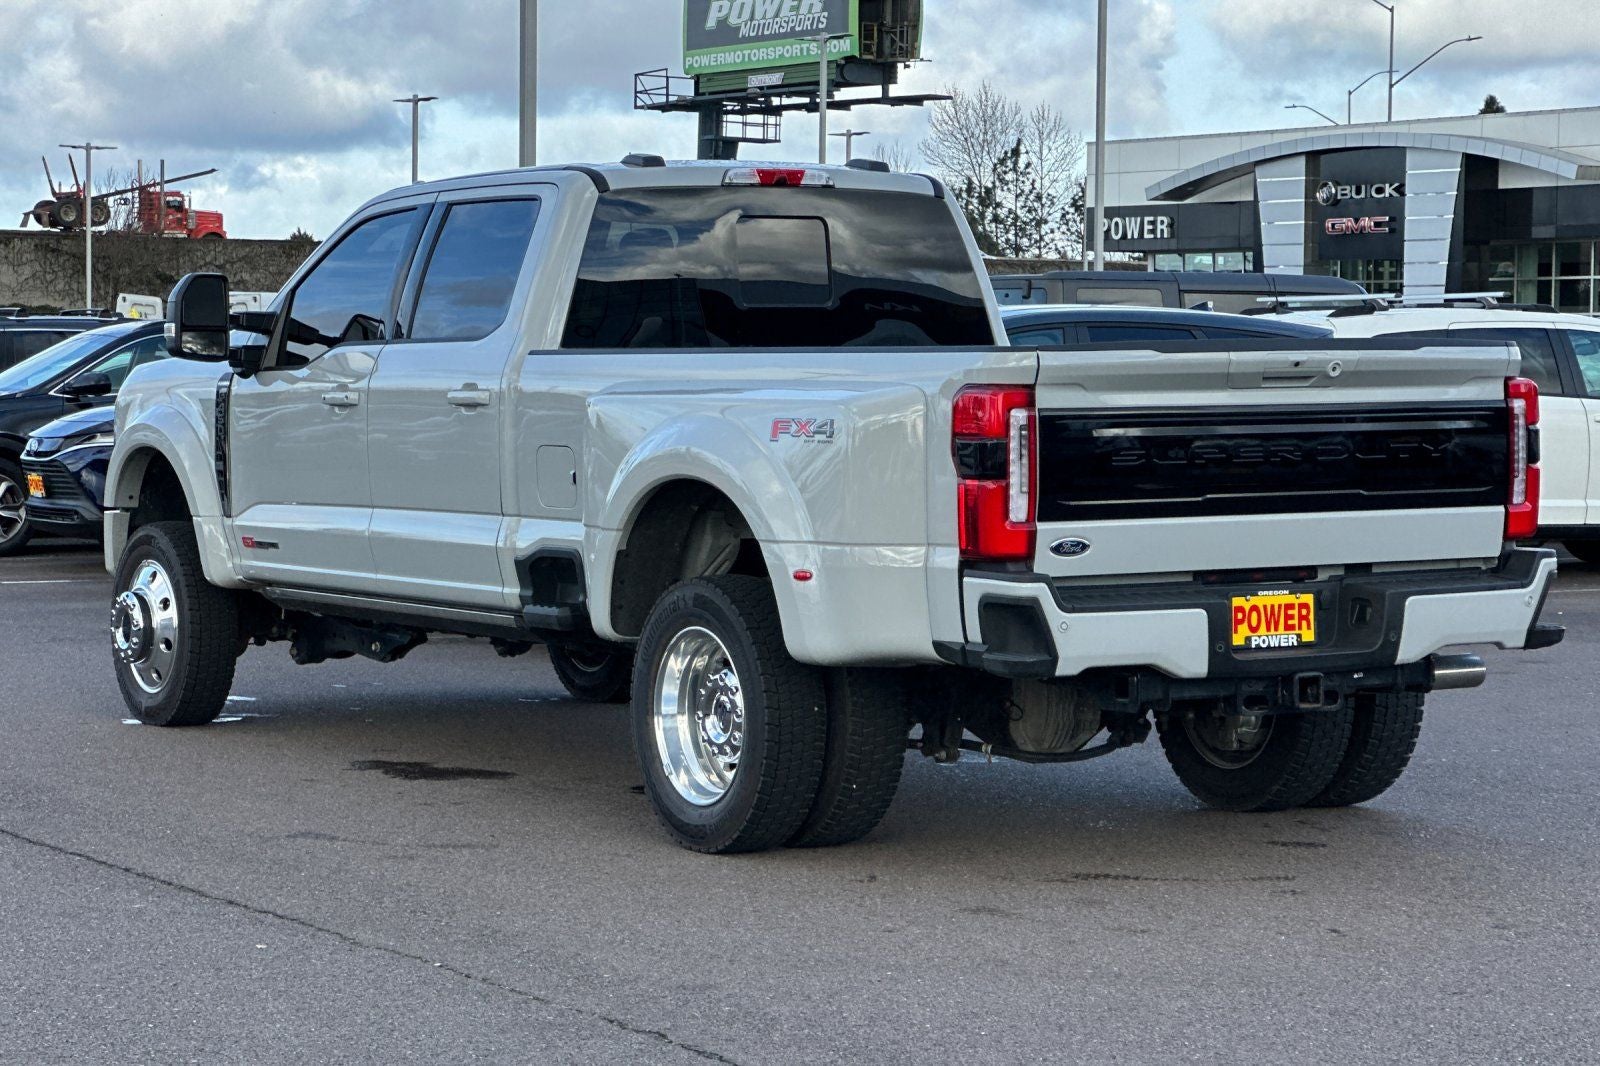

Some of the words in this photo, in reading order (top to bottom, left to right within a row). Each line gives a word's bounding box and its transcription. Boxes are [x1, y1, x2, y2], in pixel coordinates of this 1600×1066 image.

[739, 11, 829, 38] MOTORSPORTS
[685, 38, 851, 69] POWERMOTORSPORTS.OM
[1337, 182, 1401, 200] BUICK
[1325, 216, 1389, 235] GMC
[770, 418, 834, 442] FX4
[1060, 541, 1083, 553] Ford
[1233, 602, 1312, 634] POWER
[1251, 634, 1298, 648] POWER
